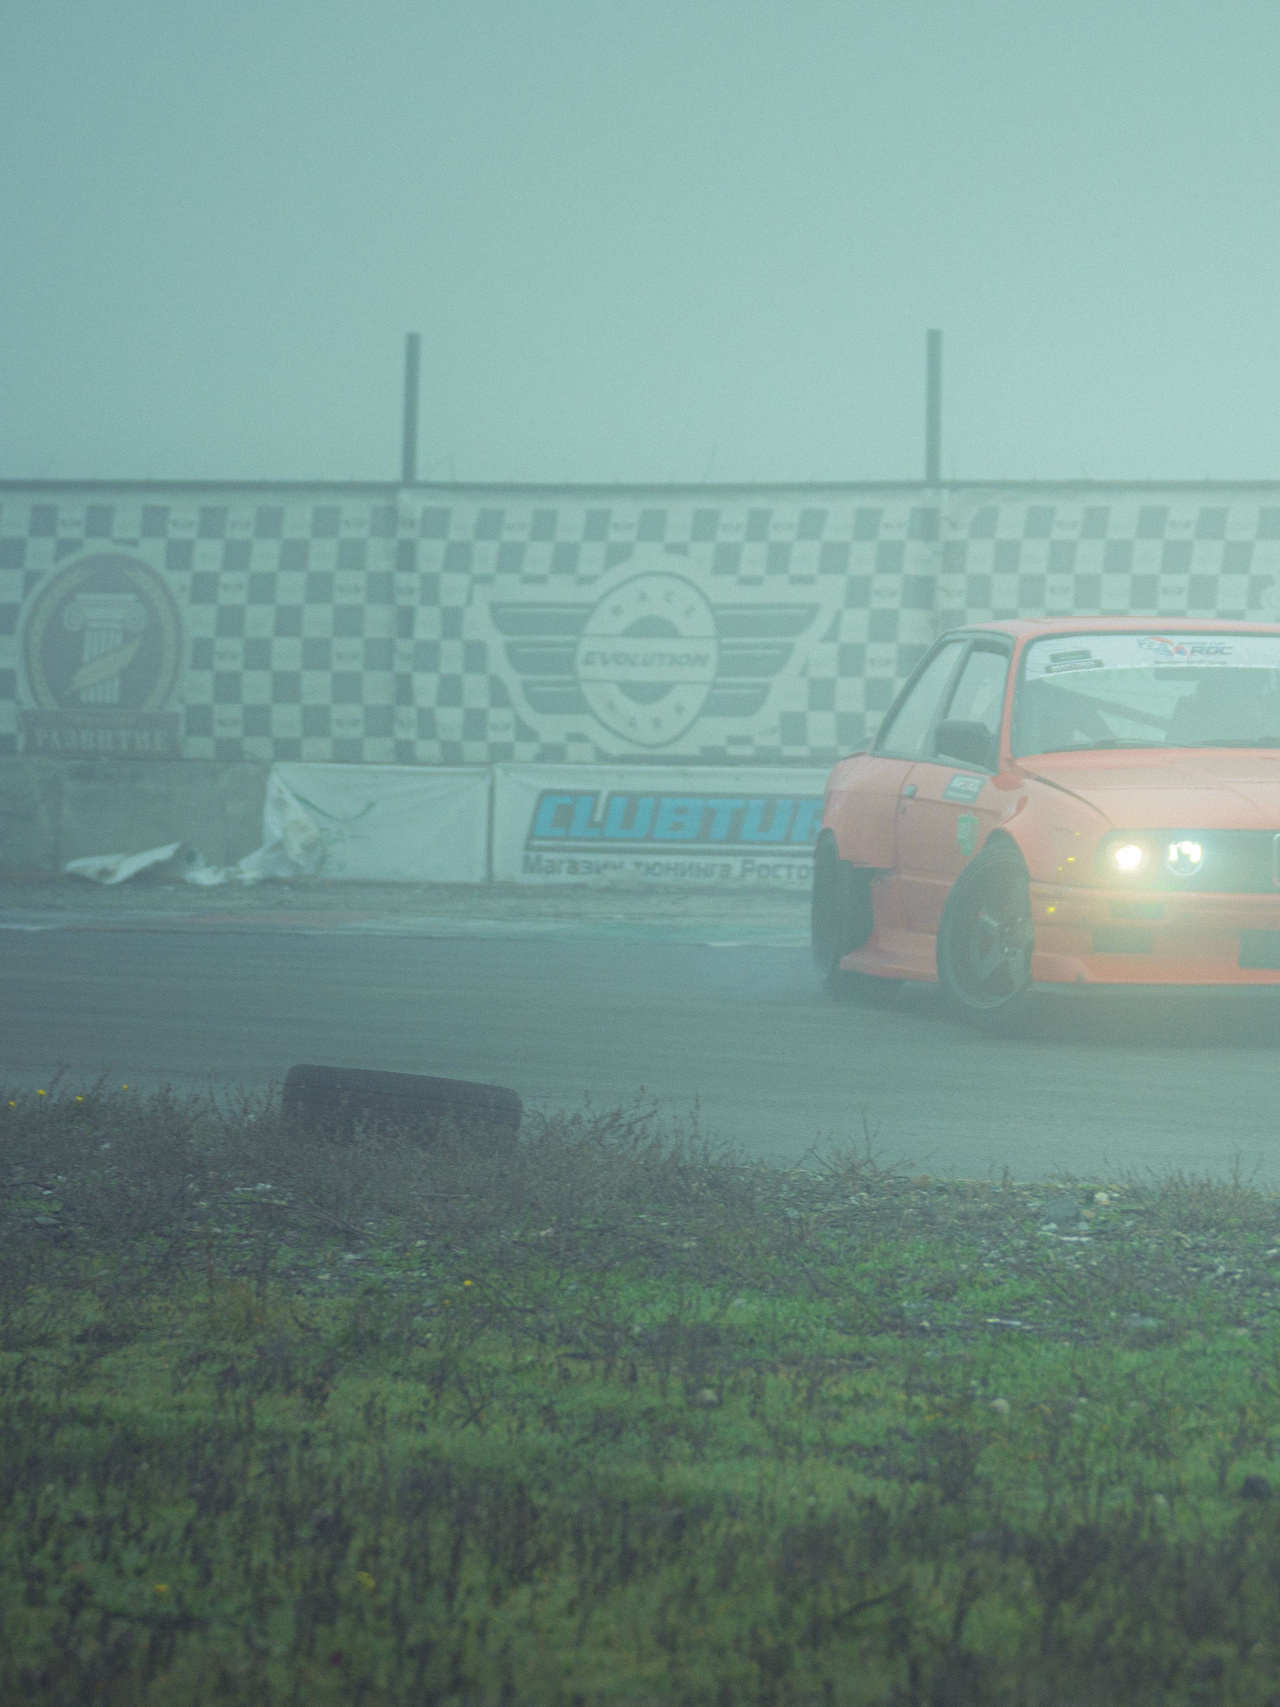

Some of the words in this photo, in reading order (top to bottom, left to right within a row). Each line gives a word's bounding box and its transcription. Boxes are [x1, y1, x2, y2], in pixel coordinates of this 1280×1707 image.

[581, 650, 711, 667] EVOLUTION
[34, 728, 168, 753] РАЗВИТИЕ
[533, 795, 824, 842] CLUBTUR
